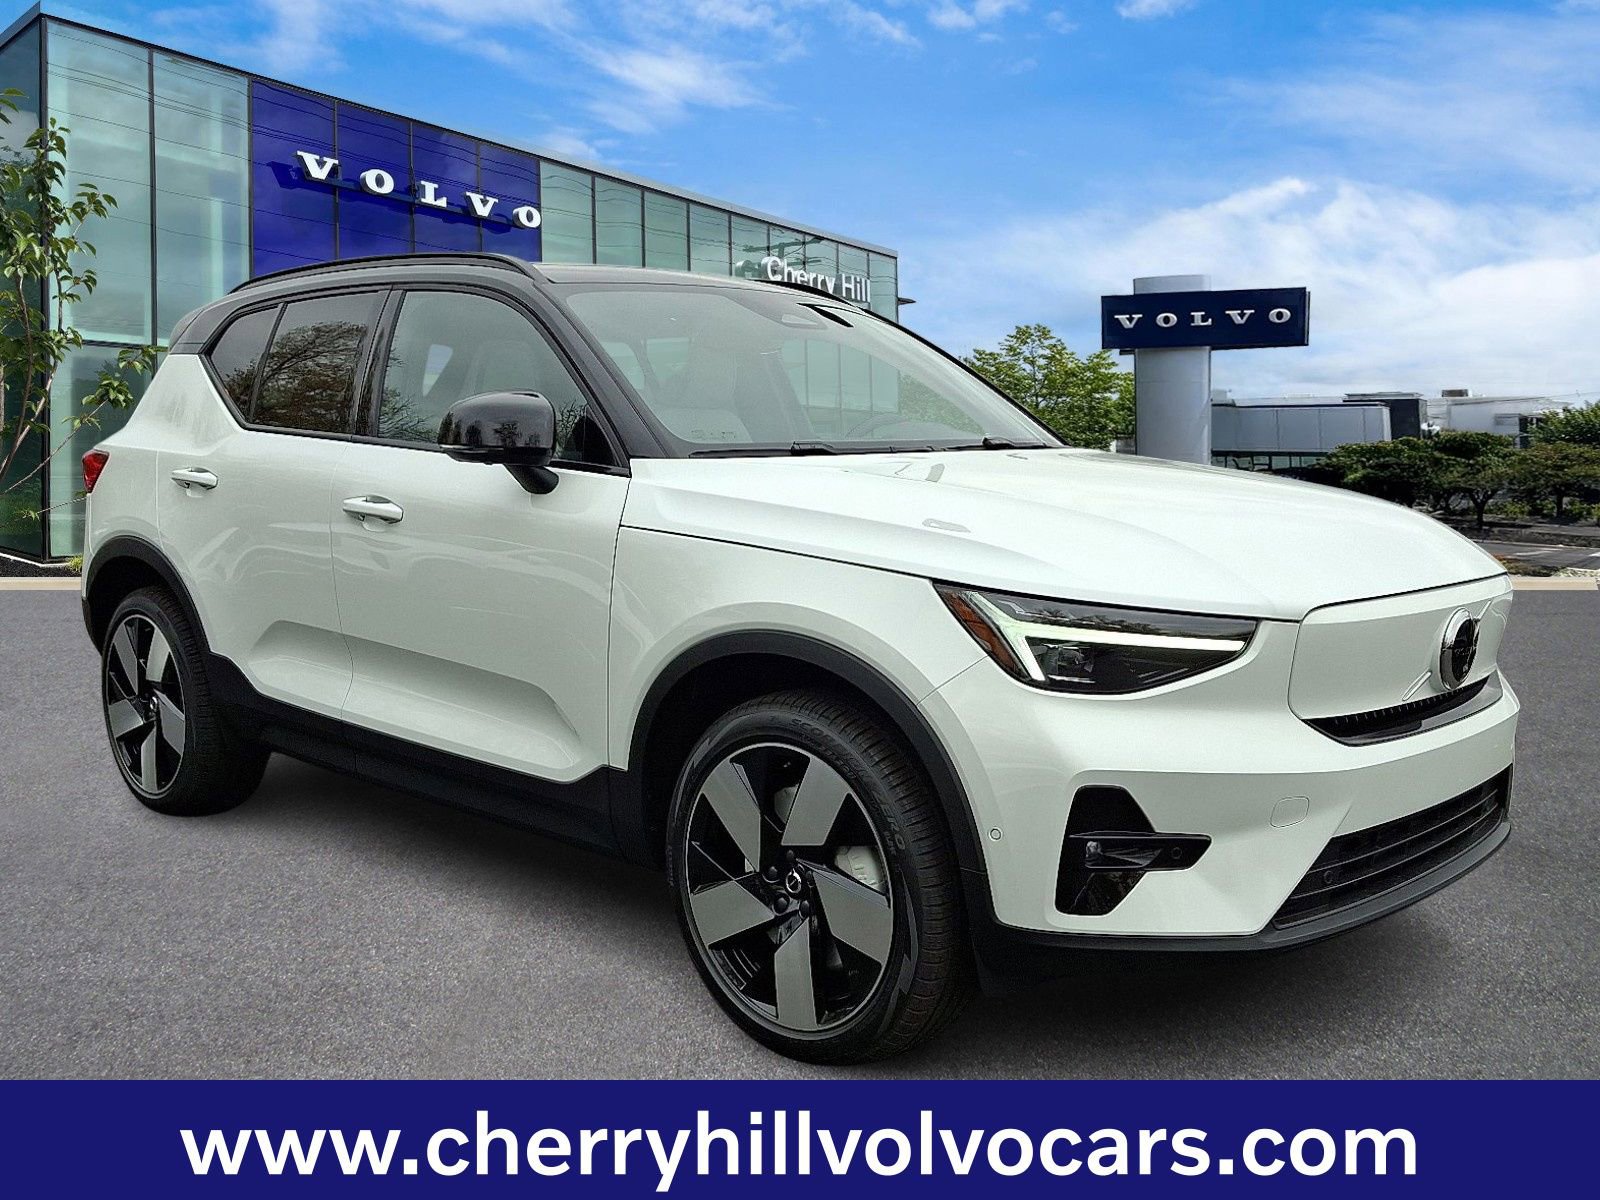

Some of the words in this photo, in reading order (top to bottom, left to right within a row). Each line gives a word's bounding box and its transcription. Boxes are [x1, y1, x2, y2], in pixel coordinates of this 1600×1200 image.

[296, 150, 542, 229] VOLVO
[764, 256, 836, 294] Cherry
[841, 273, 871, 302] Hill
[1113, 308, 1292, 329] VOLVO
